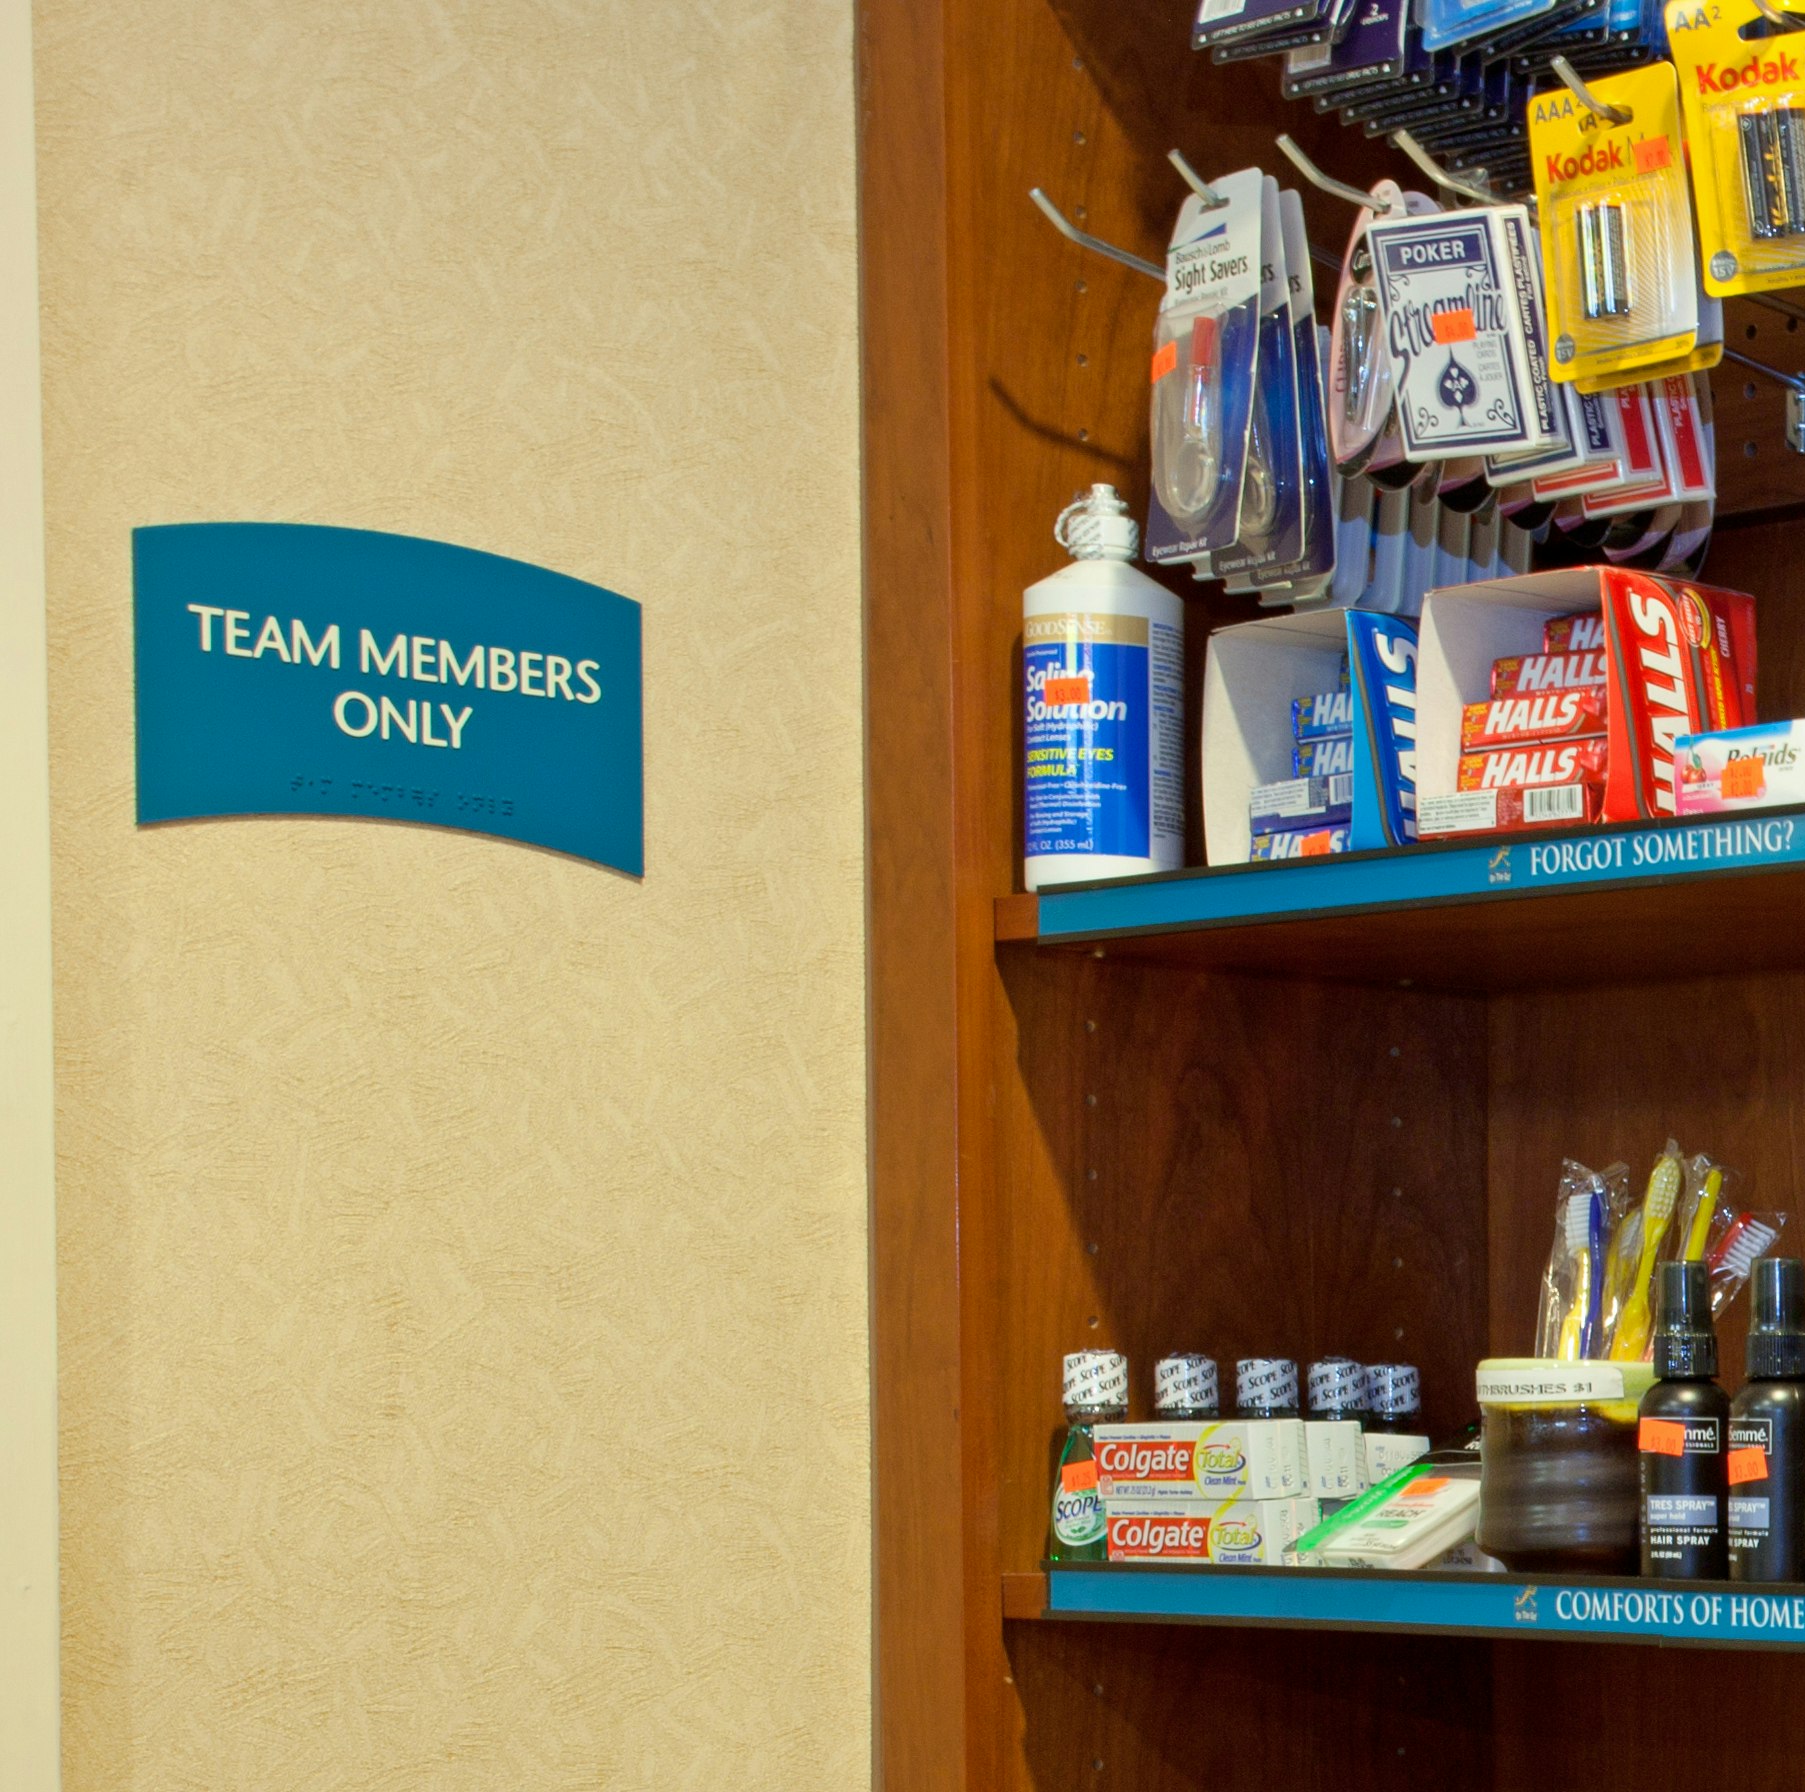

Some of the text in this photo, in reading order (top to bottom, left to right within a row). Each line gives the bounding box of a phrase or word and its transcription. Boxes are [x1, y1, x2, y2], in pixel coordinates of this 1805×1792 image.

[1696, 52, 1800, 95] Kodak
[1546, 140, 1623, 184] Kodak
[1401, 240, 1465, 265] POKER
[1174, 253, 1249, 295] Sight Savers
[1718, 615, 1730, 658] CHERRY
[188, 604, 603, 706] TEAM MEMBERS
[1027, 695, 1128, 723] Solution
[1055, 686, 1082, 702] $3.00
[1626, 586, 1697, 818] HALLS
[333, 691, 473, 750] ONLY
[1486, 693, 1582, 738] HALLS
[1078, 748, 1114, 762] EYES
[1482, 745, 1579, 791] HALLS
[1530, 819, 1796, 877] FORGOT SOMETHING?
[1099, 1443, 1191, 1479] Colgate
[1198, 1449, 1240, 1469] Total
[1204, 1475, 1238, 1487] Clean Mint
[1055, 1496, 1102, 1524] SCOPE
[1650, 1499, 1673, 1511] TRES
[1111, 1519, 1206, 1554] Colgate
[1214, 1527, 1256, 1545] Total
[1650, 1535, 1711, 1546] HAIR SPRAY
[1555, 1589, 1805, 1630] COMFORTS OF HOME
